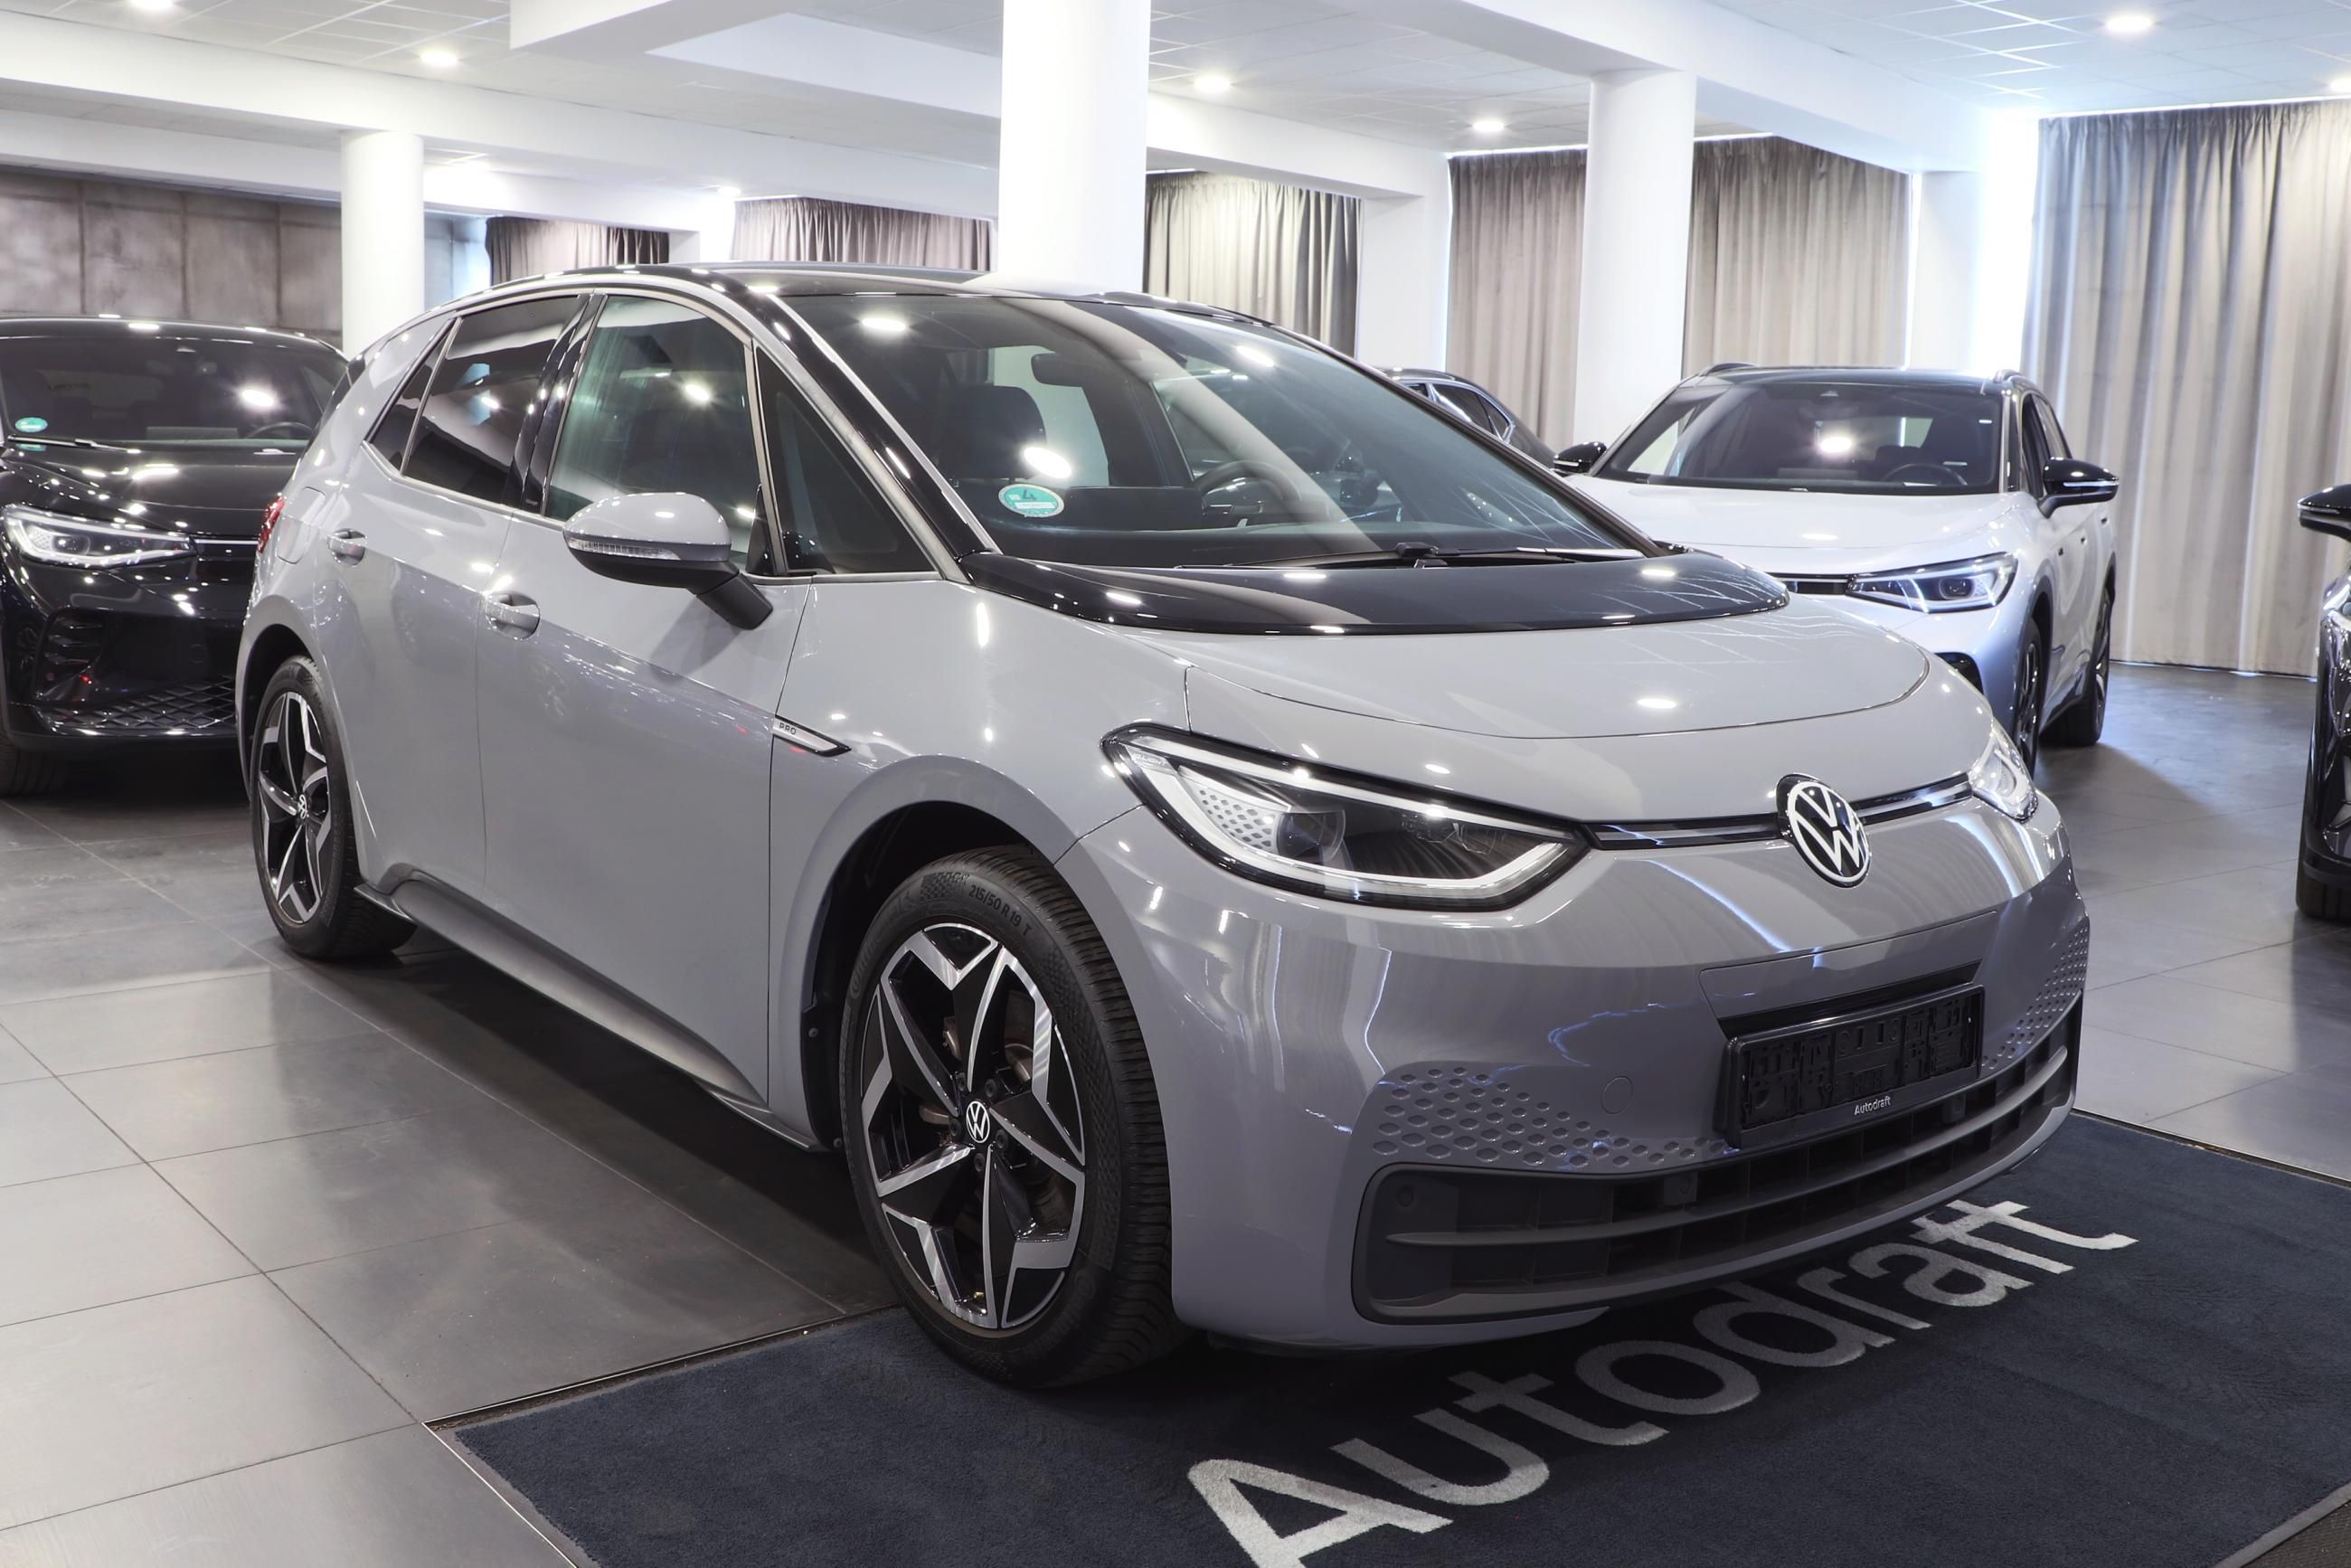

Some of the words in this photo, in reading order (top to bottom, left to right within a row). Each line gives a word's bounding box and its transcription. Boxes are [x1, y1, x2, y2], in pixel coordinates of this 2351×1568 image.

[779, 723, 797, 735] PRO
[969, 885, 1002, 910] 215/50
[1001, 903, 1010, 918] R
[1010, 912, 1022, 927] 19
[1854, 1095, 1891, 1116] Autodraft
[1188, 1198, 2139, 1568] Autodraft
